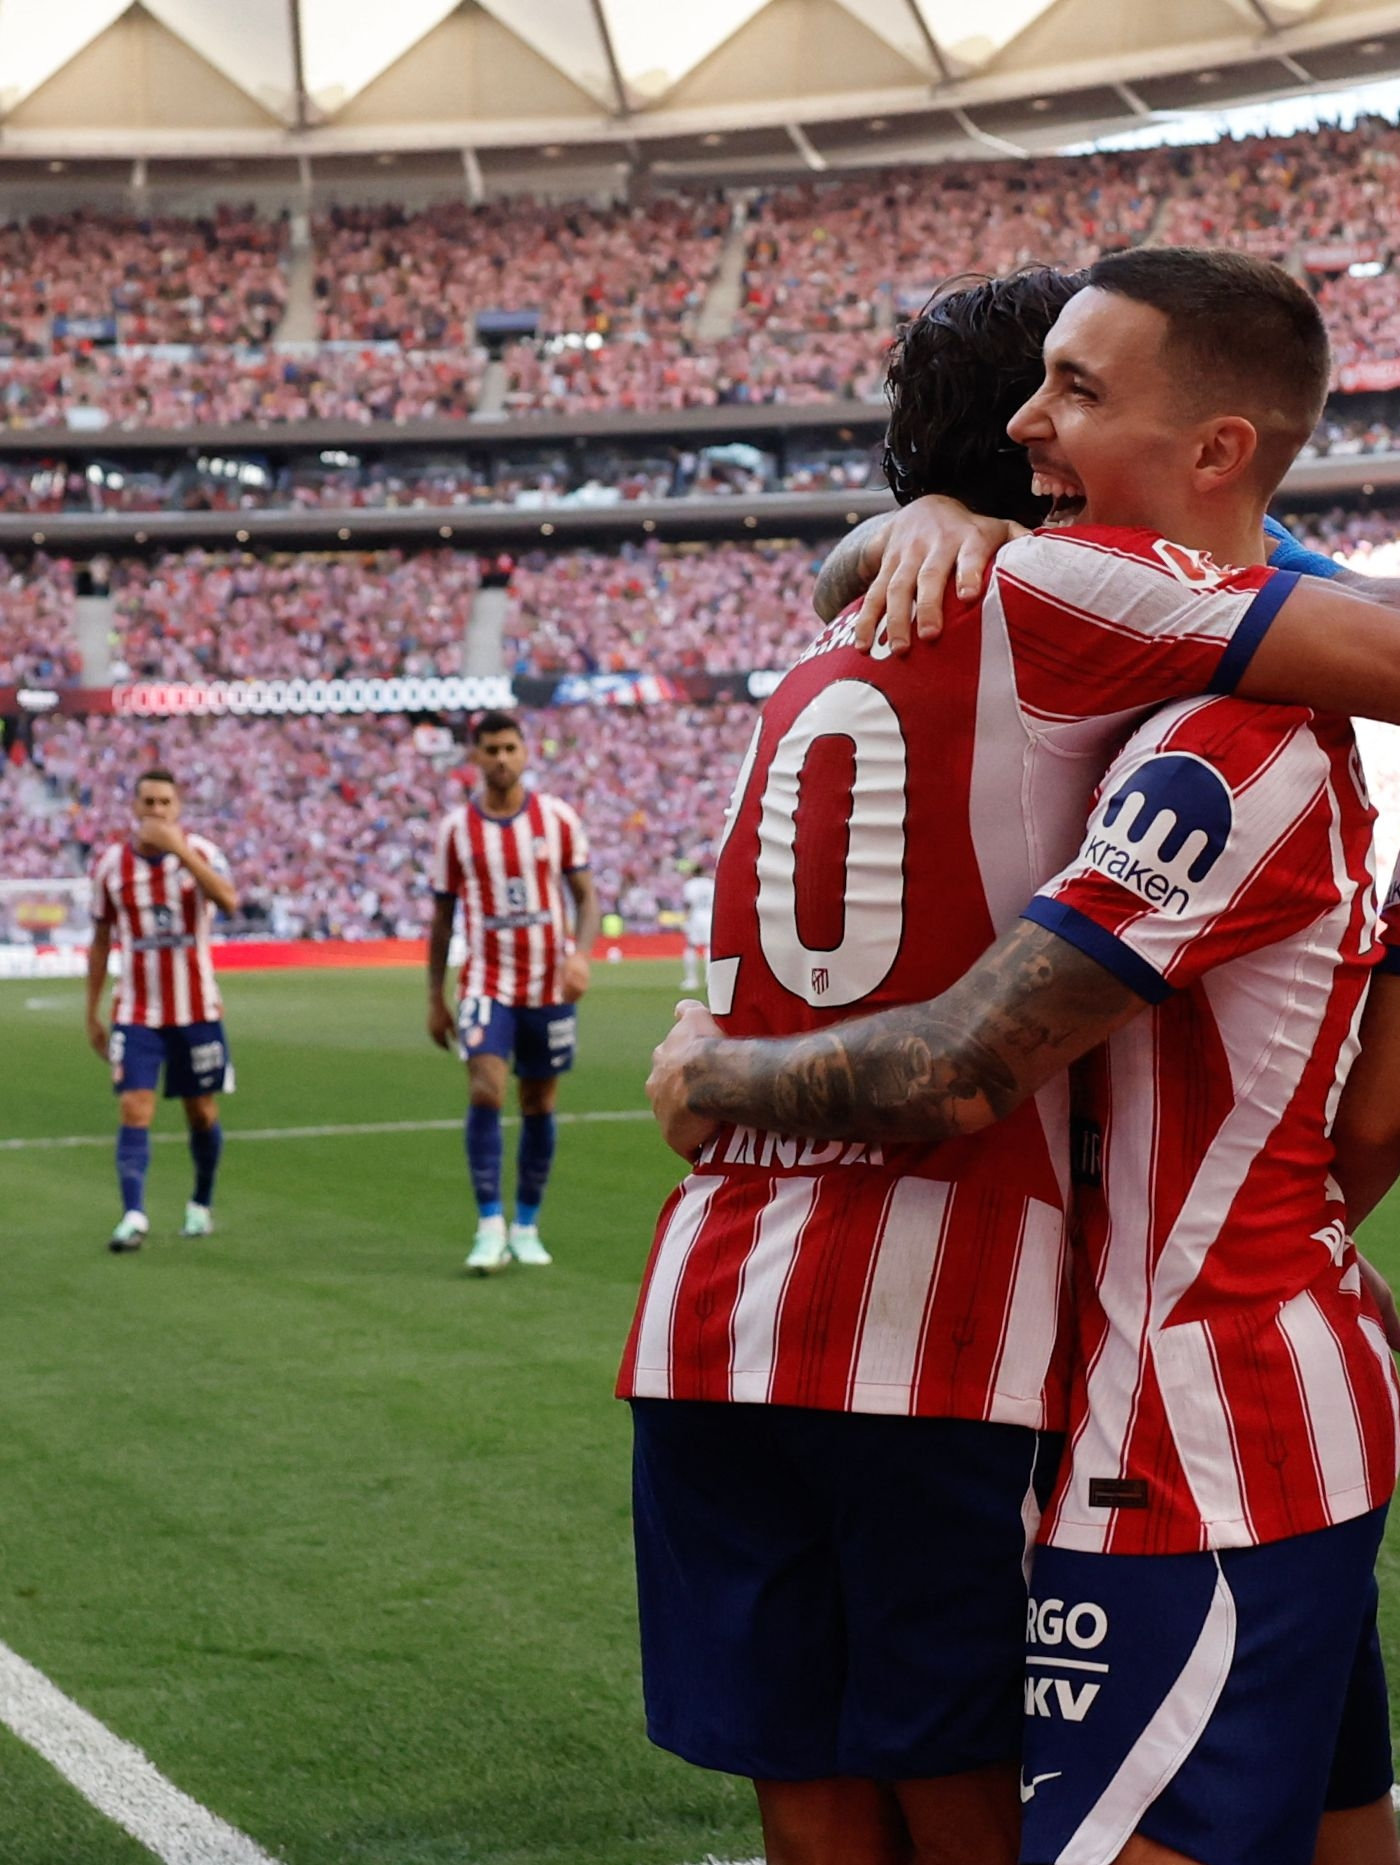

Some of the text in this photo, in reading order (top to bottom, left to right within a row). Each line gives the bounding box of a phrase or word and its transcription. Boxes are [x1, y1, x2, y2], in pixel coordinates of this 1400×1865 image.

[1085, 835, 1190, 915] kraken
[1025, 1597, 1108, 1650] RGO
[1024, 1676, 1101, 1722] KV
